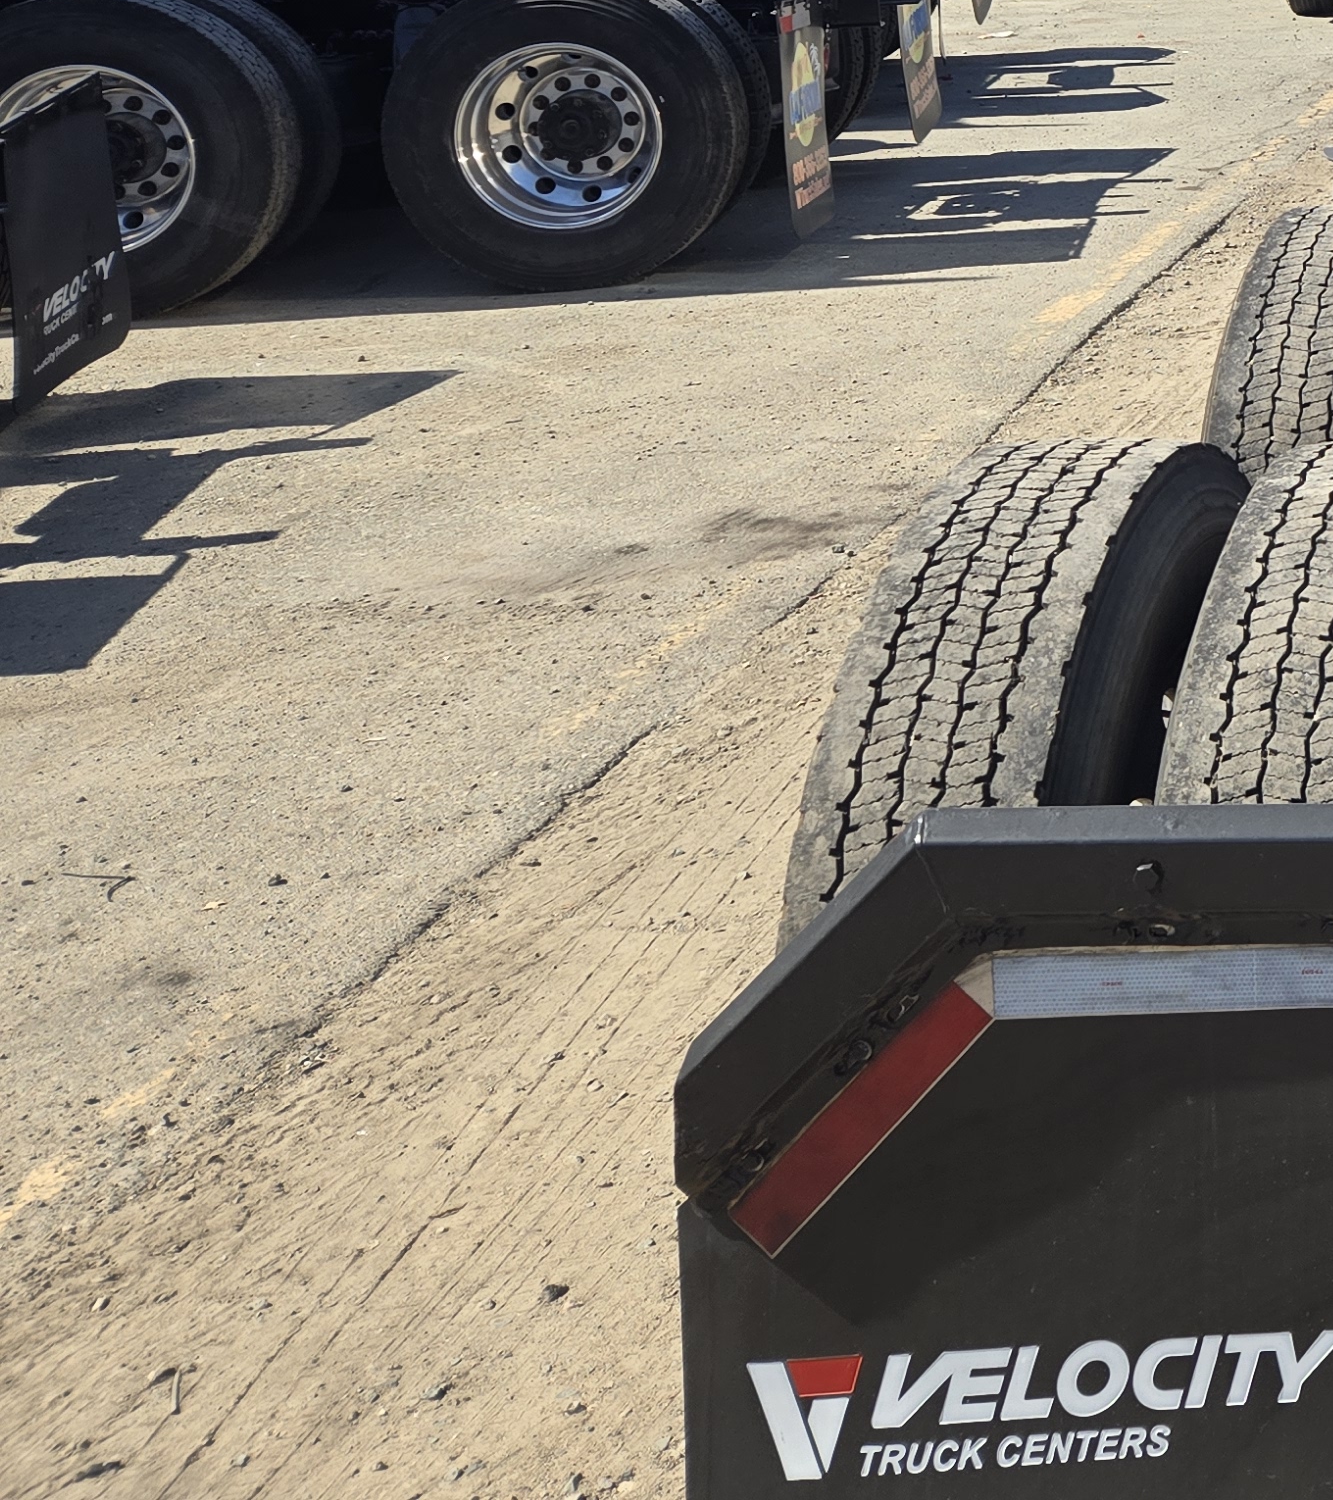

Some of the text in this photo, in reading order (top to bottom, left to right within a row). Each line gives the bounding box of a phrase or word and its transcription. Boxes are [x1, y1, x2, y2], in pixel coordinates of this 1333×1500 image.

[43, 251, 115, 322] VELOCTY
[859, 1424, 1171, 1477] TRUCK CENTERS
